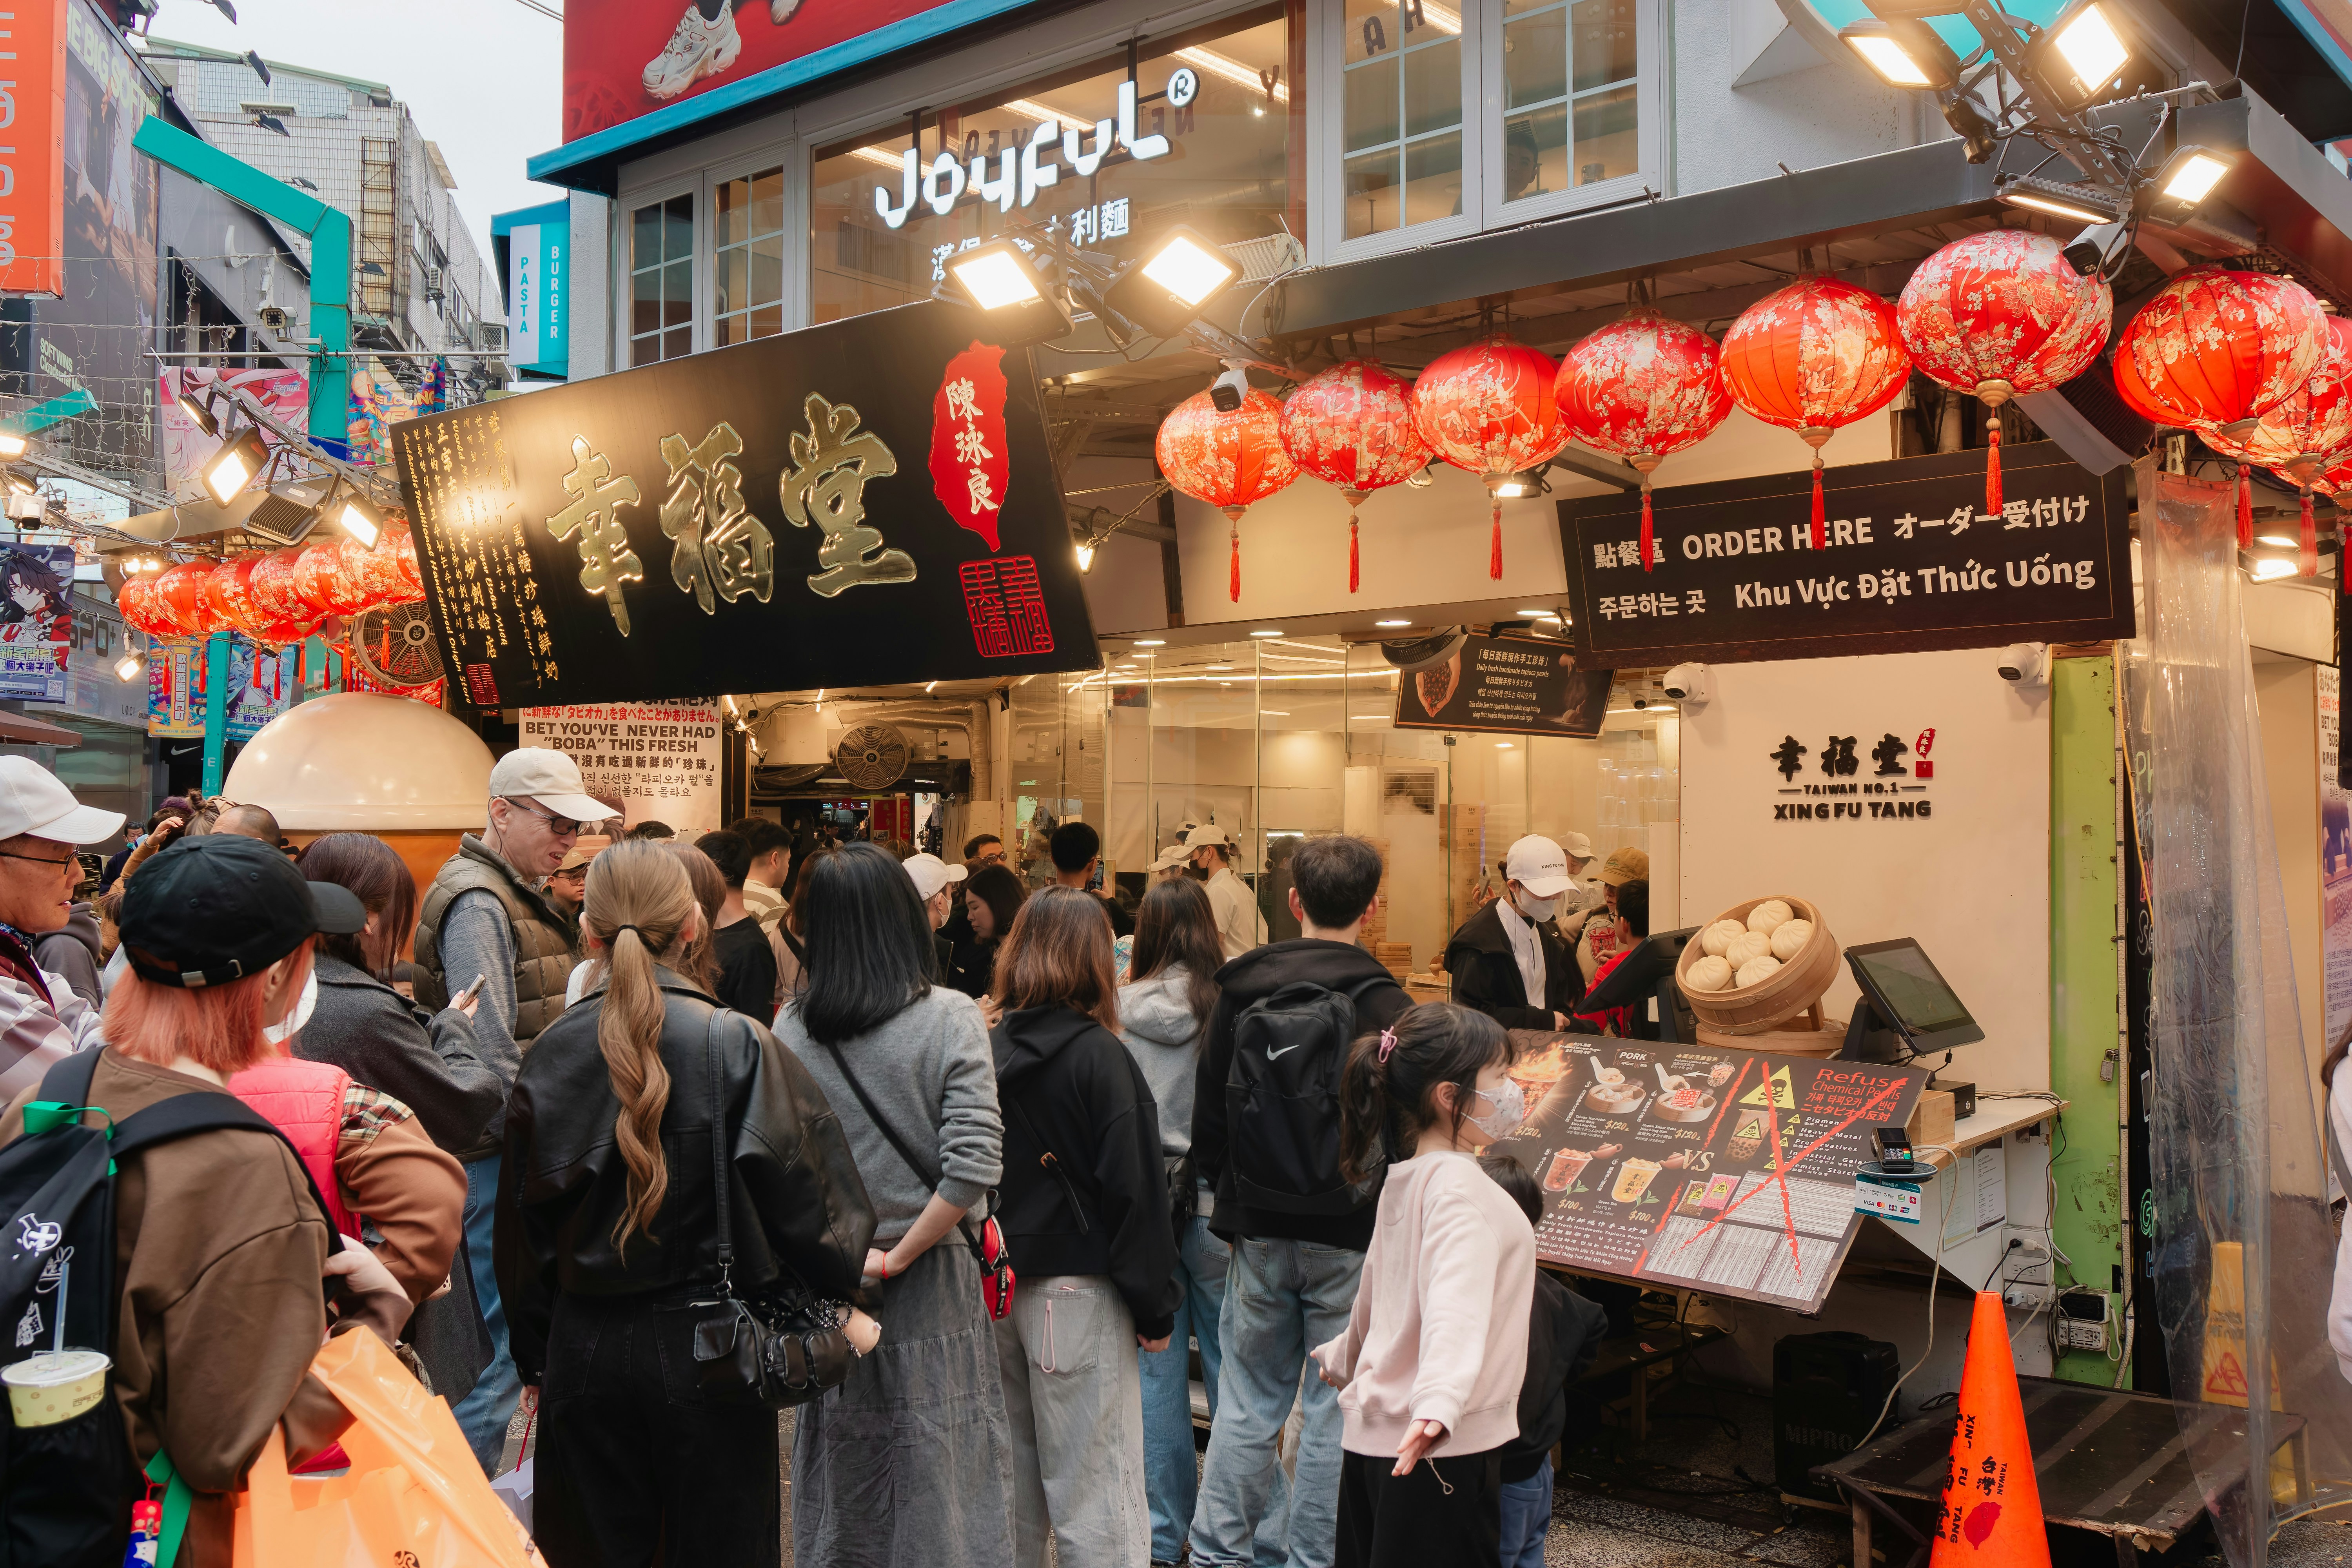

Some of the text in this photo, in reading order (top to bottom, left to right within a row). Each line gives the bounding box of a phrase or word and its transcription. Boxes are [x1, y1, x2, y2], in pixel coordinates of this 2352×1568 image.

[84, 22, 109, 85] BIG
[2074, 82, 2089, 100] LEDVANCE
[520, 257, 528, 332] PASTA
[550, 246, 559, 338] BURGER
[1027, 297, 1044, 306] LEDVANCE
[1174, 298, 1192, 310] LEDVANCE
[56, 348, 72, 373] WINS
[545, 392, 917, 637] 幸福堂
[1893, 495, 2090, 538] オーダー受付け
[1682, 524, 1784, 561] ORDER
[402, 431, 418, 488] Authentic
[449, 637, 461, 672] Origin
[459, 675, 472, 704] Store
[1735, 551, 2096, 610] Khu Vực Đặt Thức Uống
[1599, 589, 1706, 621] 주문하는 곳
[1478, 648, 1549, 666] 「每日新鮮現作手工珍珠」
[1476, 663, 1487, 672] Daily
[1499, 666, 1521, 674] handmade
[1478, 688, 1486, 696] 매일
[1487, 689, 1503, 698] 신선하게
[1504, 690, 1516, 699] 만드는
[236, 713, 275, 724] 來個大樂子
[525, 722, 556, 734] BET
[627, 724, 679, 737] NEVER
[682, 726, 715, 738] HAD
[609, 739, 645, 751] THIS
[648, 739, 698, 752] FRESH
[207, 757, 216, 767] E
[1769, 733, 1908, 782] 幸福堂
[599, 773, 632, 785] 신선한
[1803, 782, 1899, 794] TAIWAN NO.1
[611, 786, 654, 798] 없을지도
[1773, 800, 1931, 819] XING FU TANG
[1619, 1052, 1648, 1061] PORK
[1812, 1081, 1901, 1100] Chemical Perls
[1806, 1093, 1897, 1112] 가짜 타피오카 반대
[1800, 1128, 1828, 1136] Heavy
[1835, 1132, 1862, 1140] Metal
[1827, 1168, 1857, 1176] Starch
[1574, 1225, 1603, 1234] Handmade
[1551, 1235, 1577, 1244] 신선하게
[1785, 1423, 1854, 1451] MIPRO
[1996, 1463, 2007, 1495] TAIWAN
[1950, 1467, 1968, 1544] FU TANG
